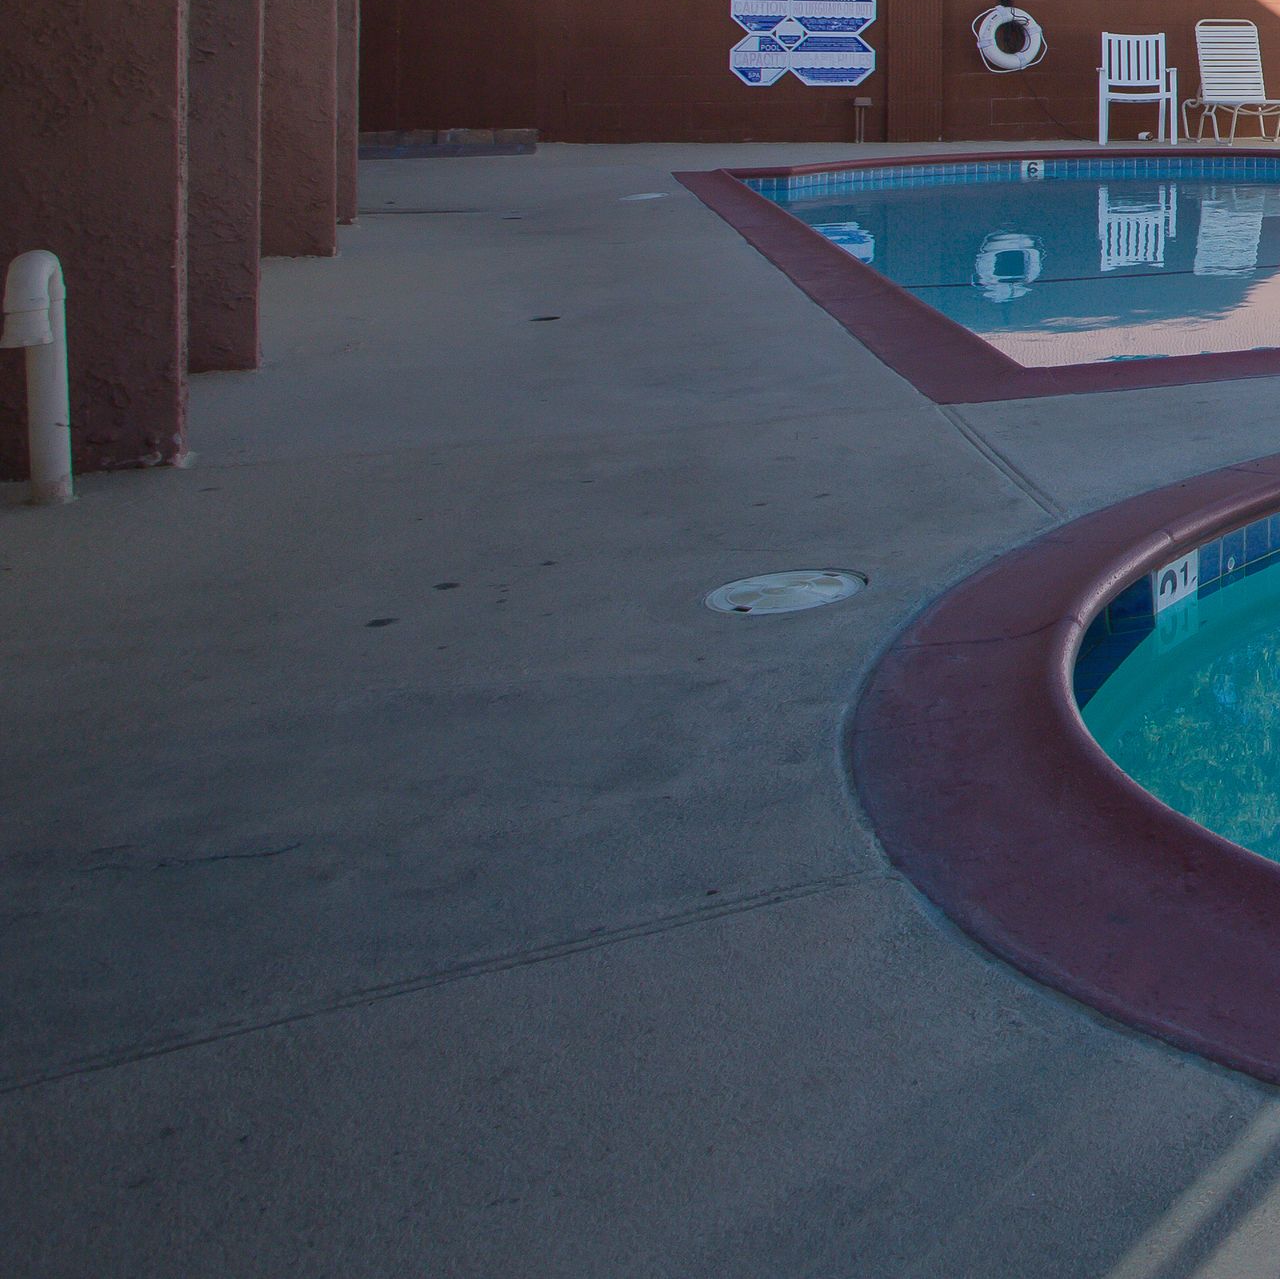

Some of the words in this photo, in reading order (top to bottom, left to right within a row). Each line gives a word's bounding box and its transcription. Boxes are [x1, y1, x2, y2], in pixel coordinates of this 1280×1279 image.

[734, 1, 787, 14] CAUTION
[760, 44, 782, 52] POOL
[734, 53, 787, 66] CAPACITY
[748, 71, 761, 79] SPA
[1026, 161, 1039, 176] 6
